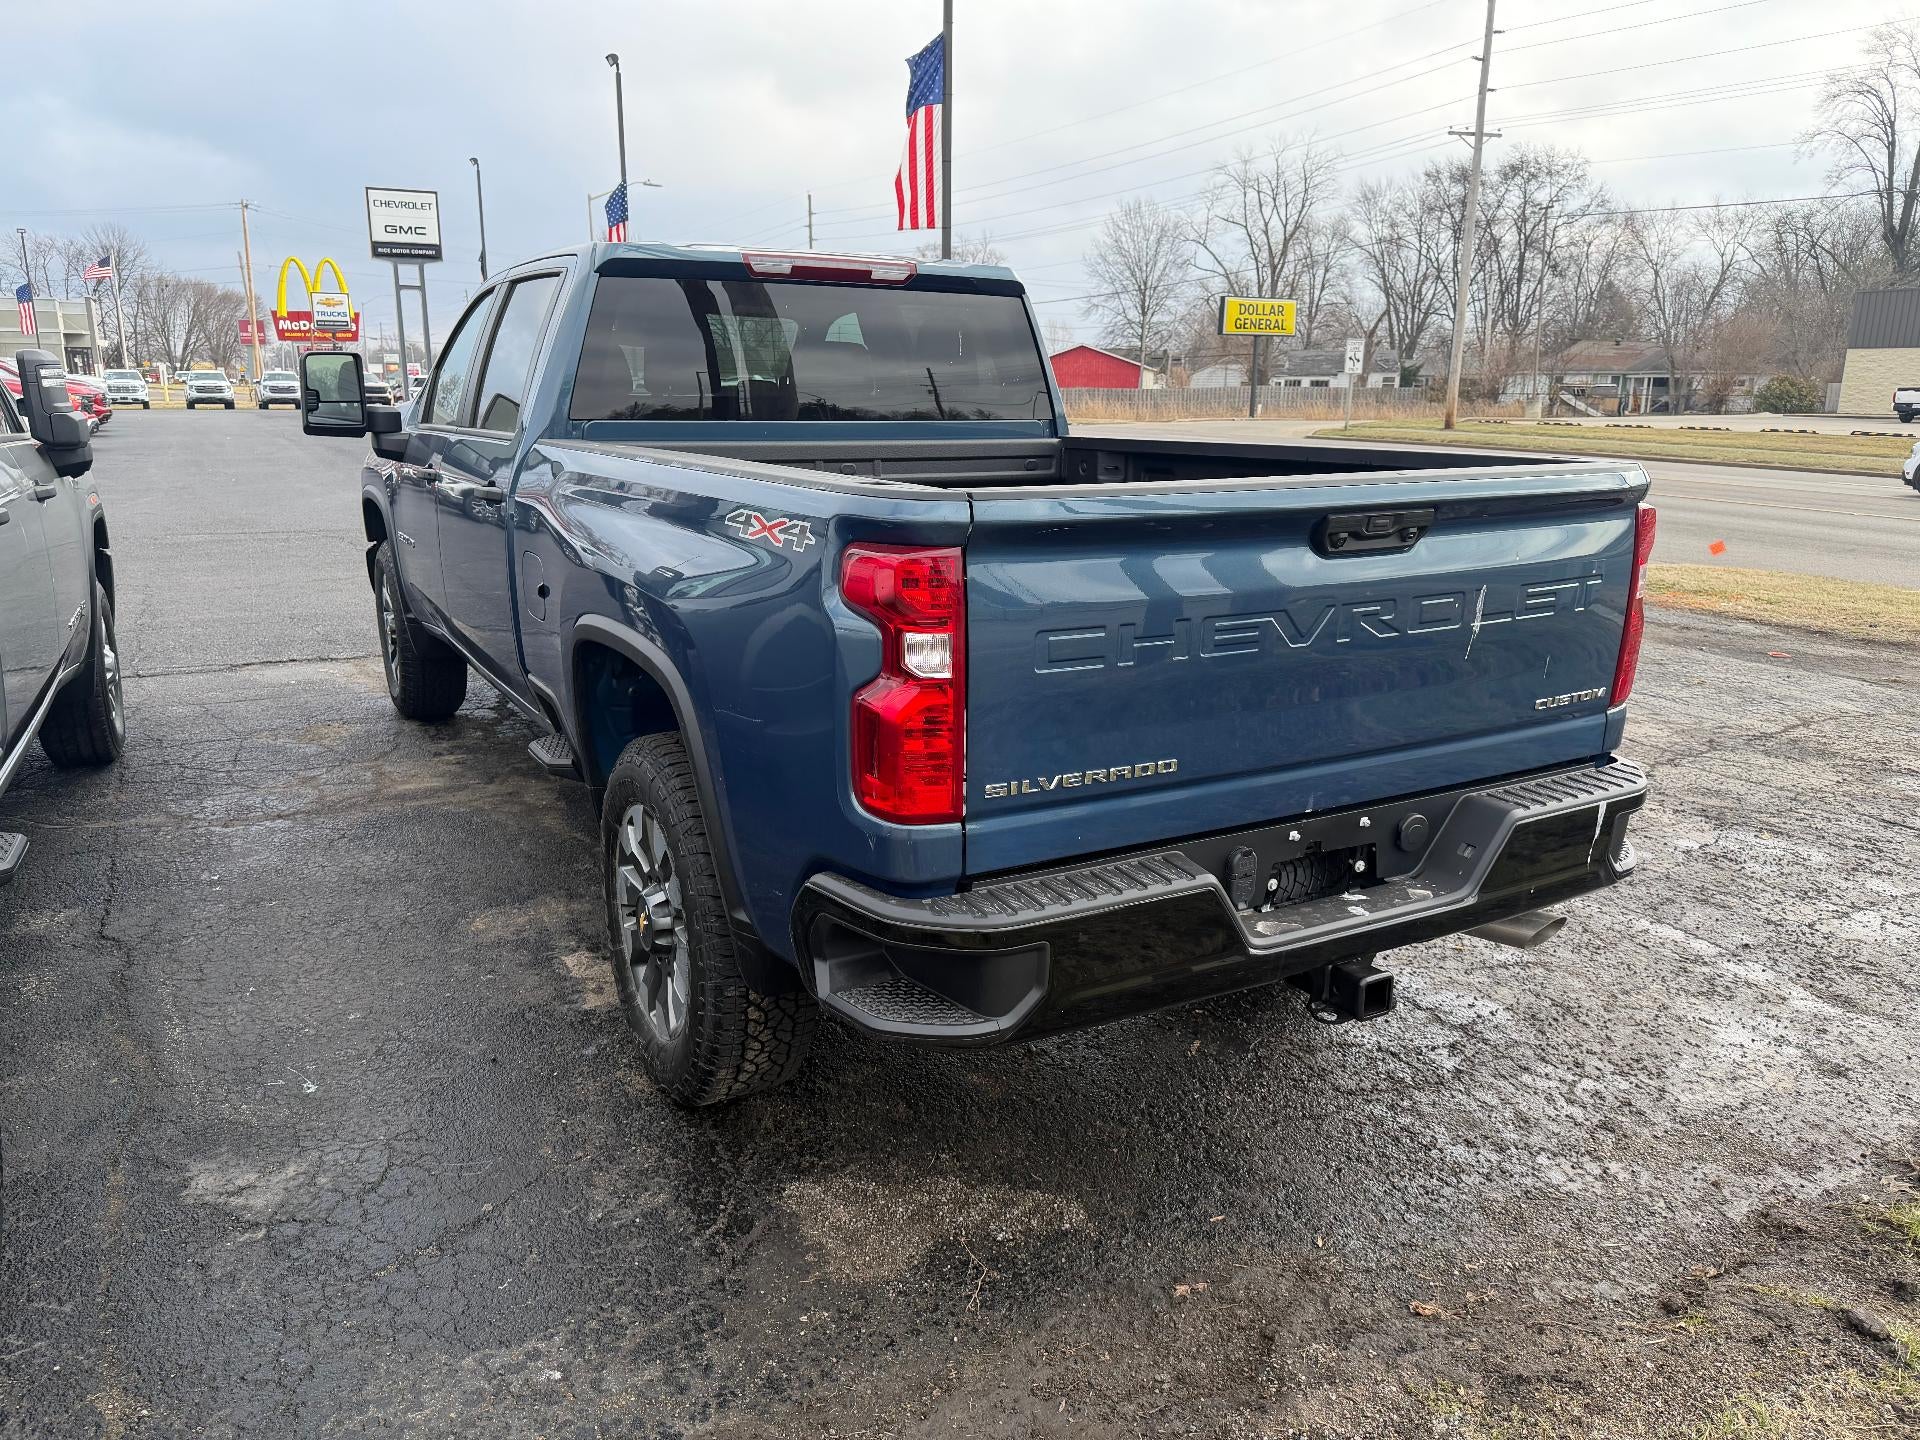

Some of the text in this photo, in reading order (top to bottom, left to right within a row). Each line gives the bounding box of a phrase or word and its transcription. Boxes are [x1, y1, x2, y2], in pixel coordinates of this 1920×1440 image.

[373, 199, 433, 211] CHEVROLET
[384, 224, 427, 236] GMC
[316, 310, 348, 318] TRUCKS
[1238, 303, 1285, 317] DOLLAR
[1234, 317, 1287, 331] GENERAL
[1034, 574, 1604, 674] CHEVROLET
[1534, 686, 1607, 710] CUSTOM
[984, 758, 1179, 799] SILVERADO
